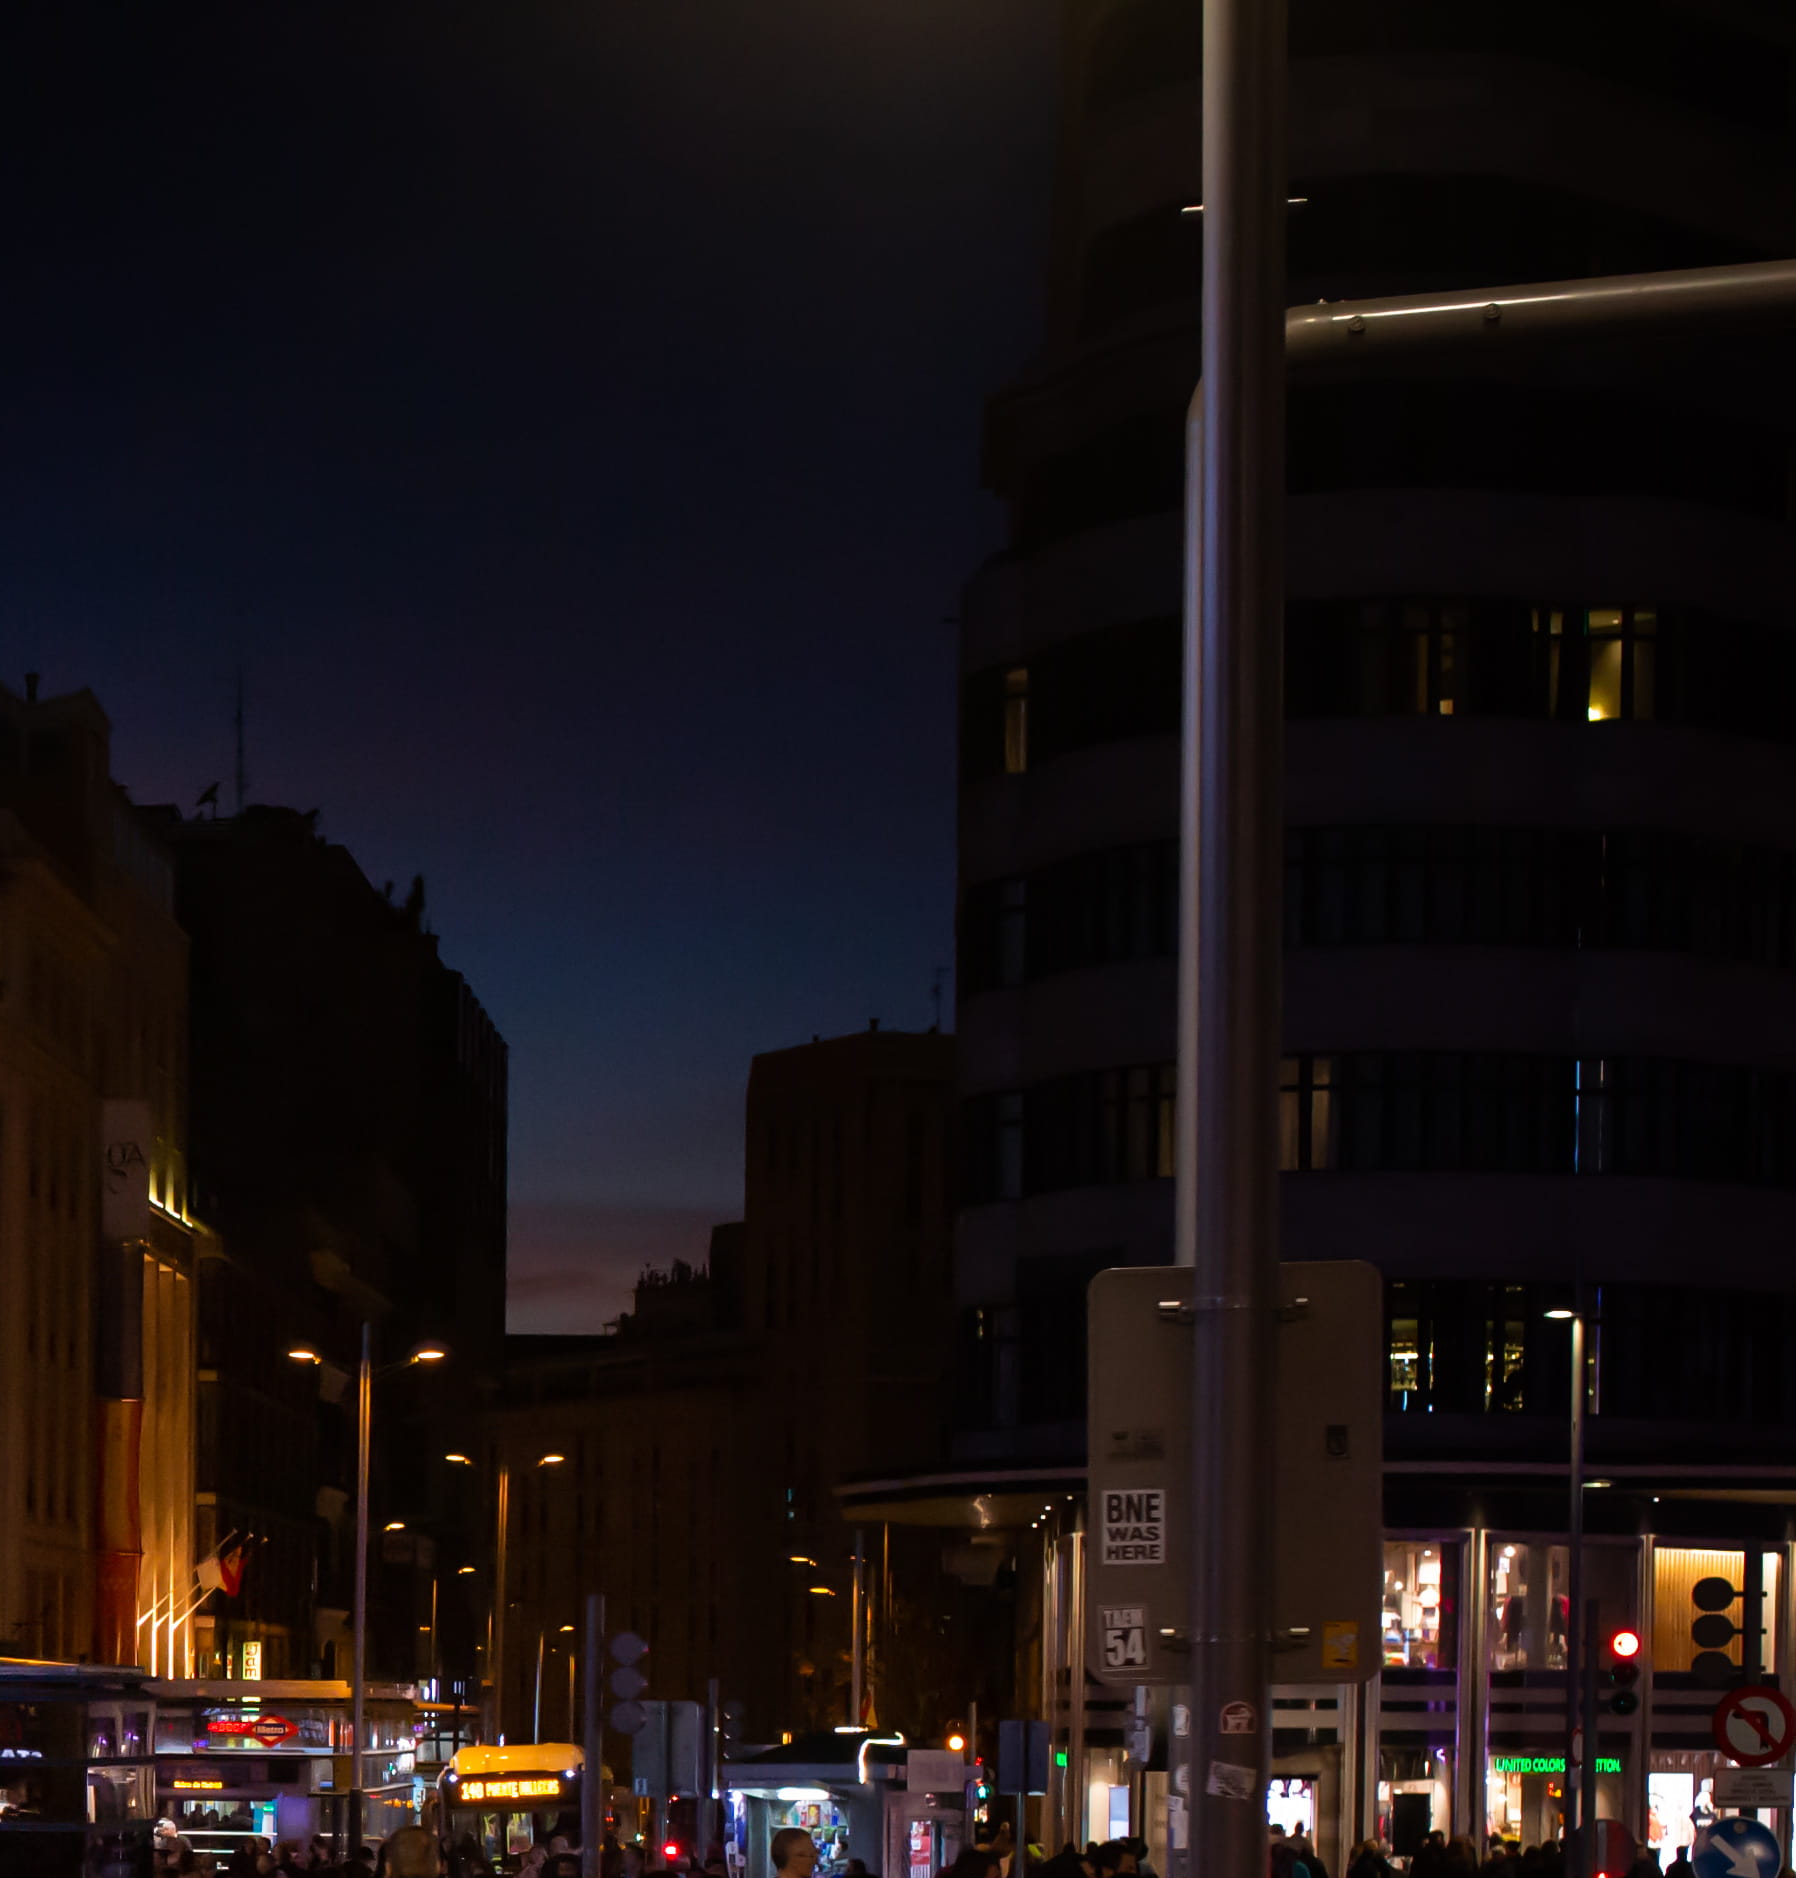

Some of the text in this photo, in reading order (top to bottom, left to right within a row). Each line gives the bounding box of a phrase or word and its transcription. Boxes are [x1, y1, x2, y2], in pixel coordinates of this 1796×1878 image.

[1107, 1494, 1161, 1524] BNE
[1108, 1526, 1160, 1542] WAS
[1108, 1544, 1161, 1561] HERE
[1495, 1758, 1532, 1772] UNITED
[1532, 1758, 1566, 1772] COLORS
